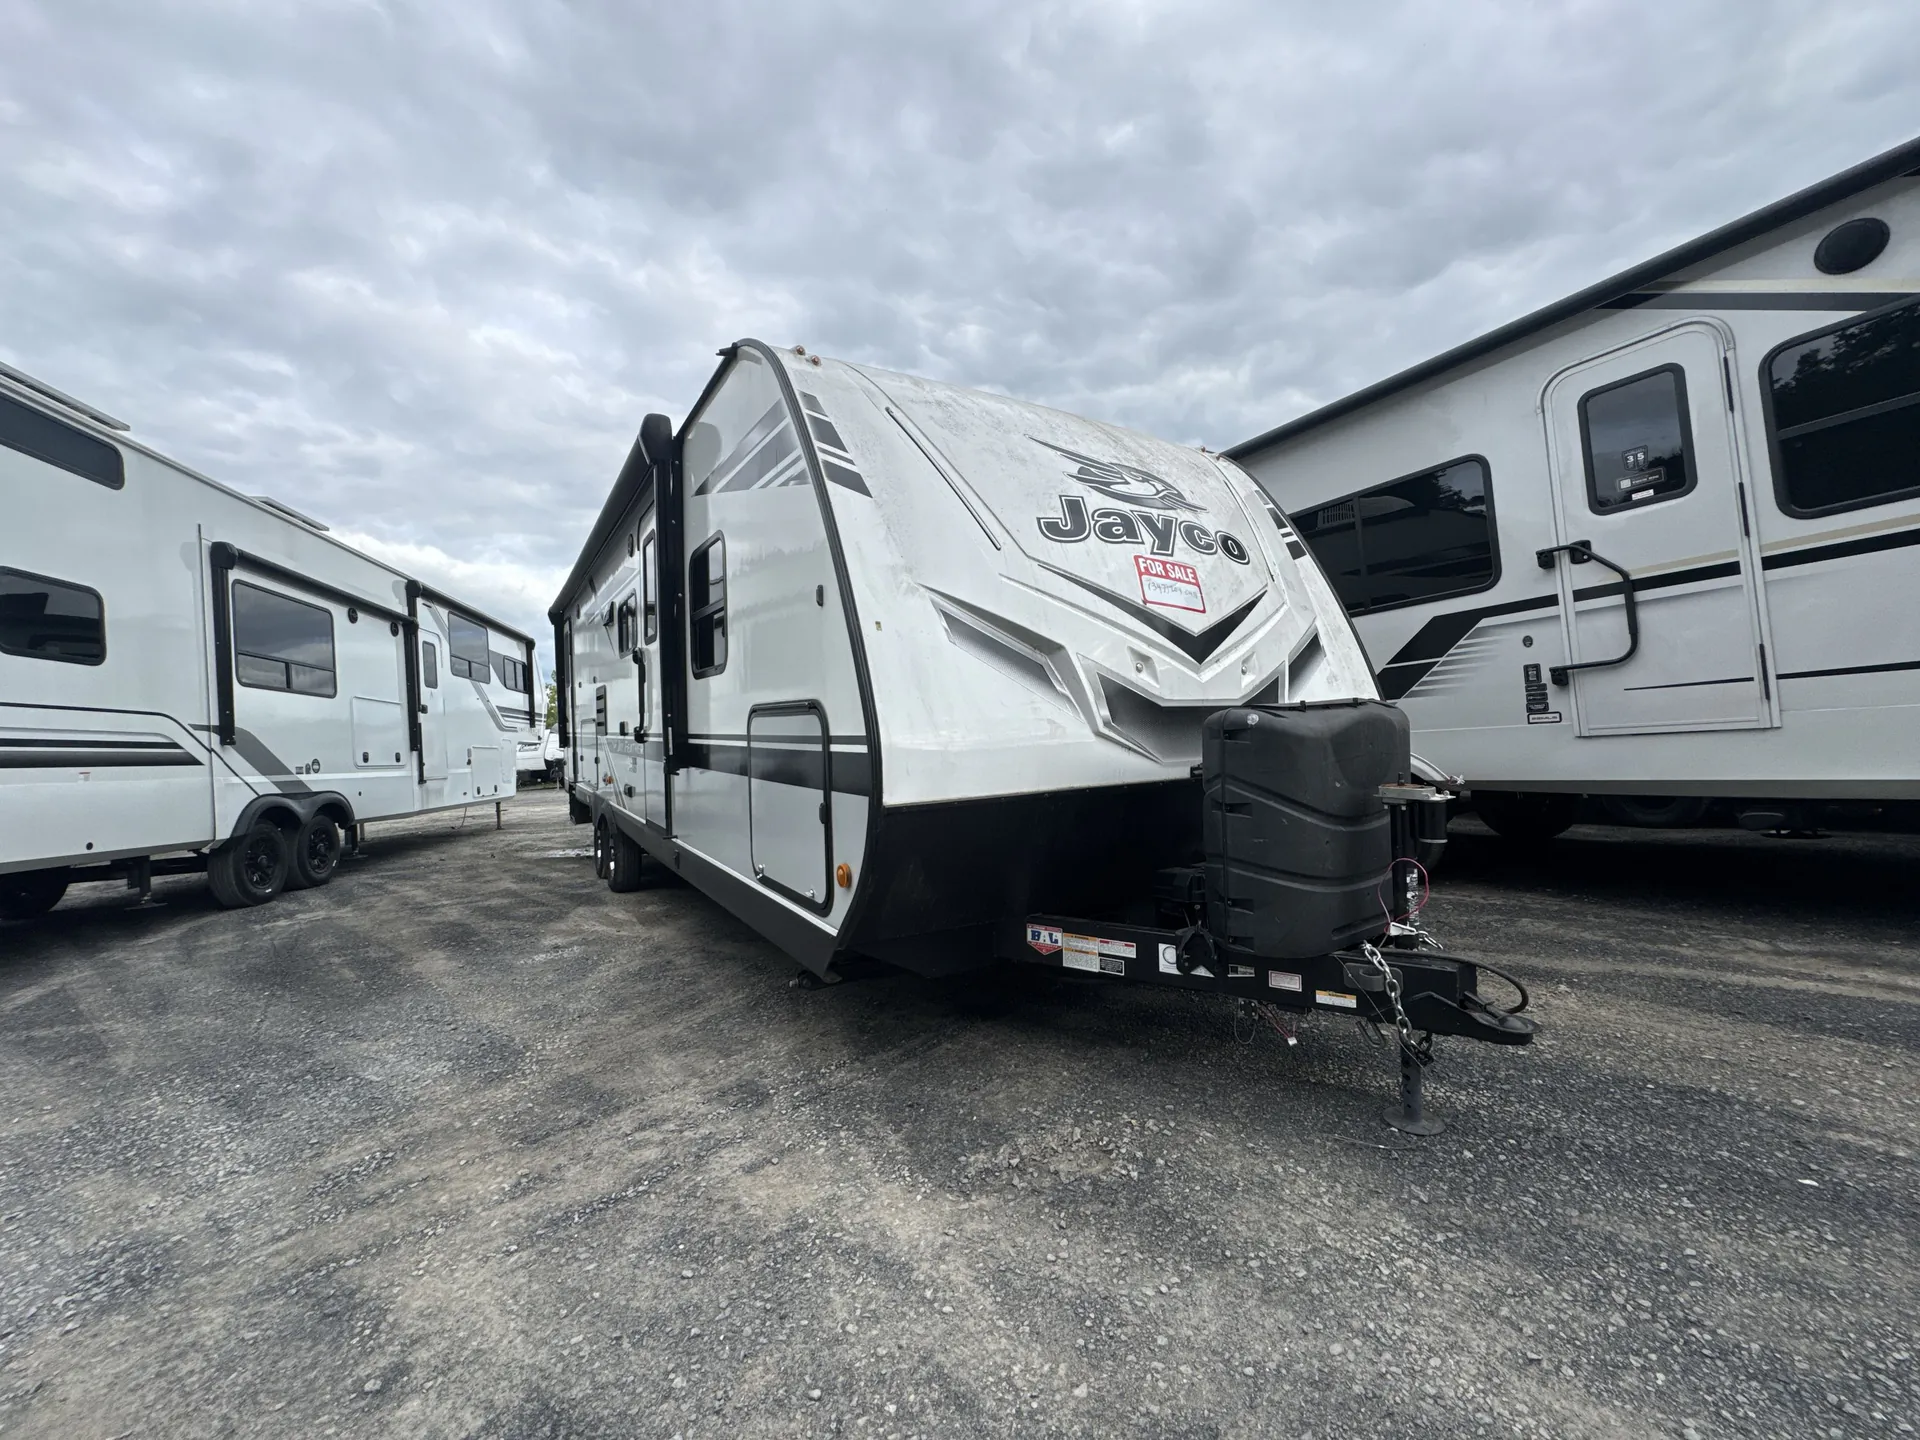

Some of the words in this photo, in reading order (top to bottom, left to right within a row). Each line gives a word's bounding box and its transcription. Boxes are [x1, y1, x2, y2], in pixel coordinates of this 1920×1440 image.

[1036, 494, 1250, 565] Jayco
[1137, 557, 1167, 577] FOR
[1165, 563, 1197, 584] SALE
